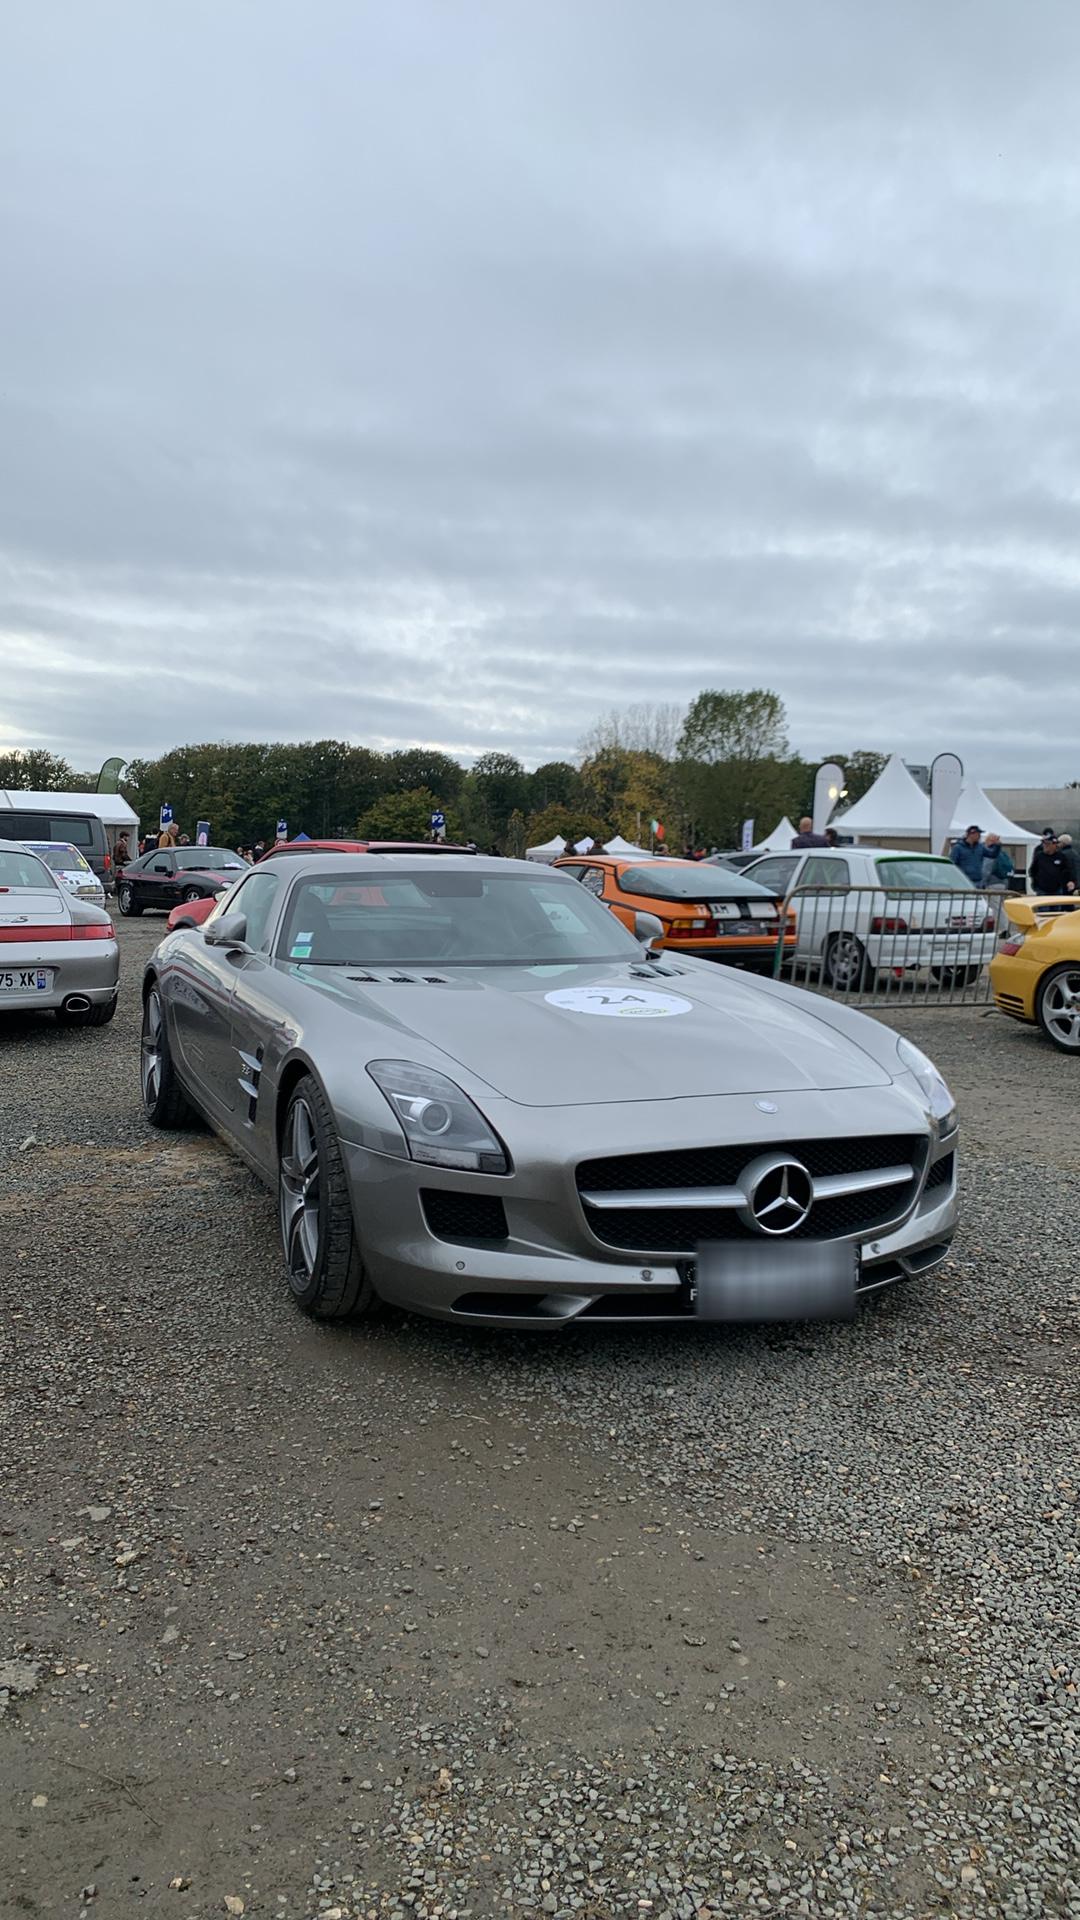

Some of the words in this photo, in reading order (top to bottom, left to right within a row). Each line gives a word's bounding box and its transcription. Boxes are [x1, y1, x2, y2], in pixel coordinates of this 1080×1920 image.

[162, 808, 173, 818] P1
[431, 814, 445, 824] P2
[586, 994, 648, 1005] 24
